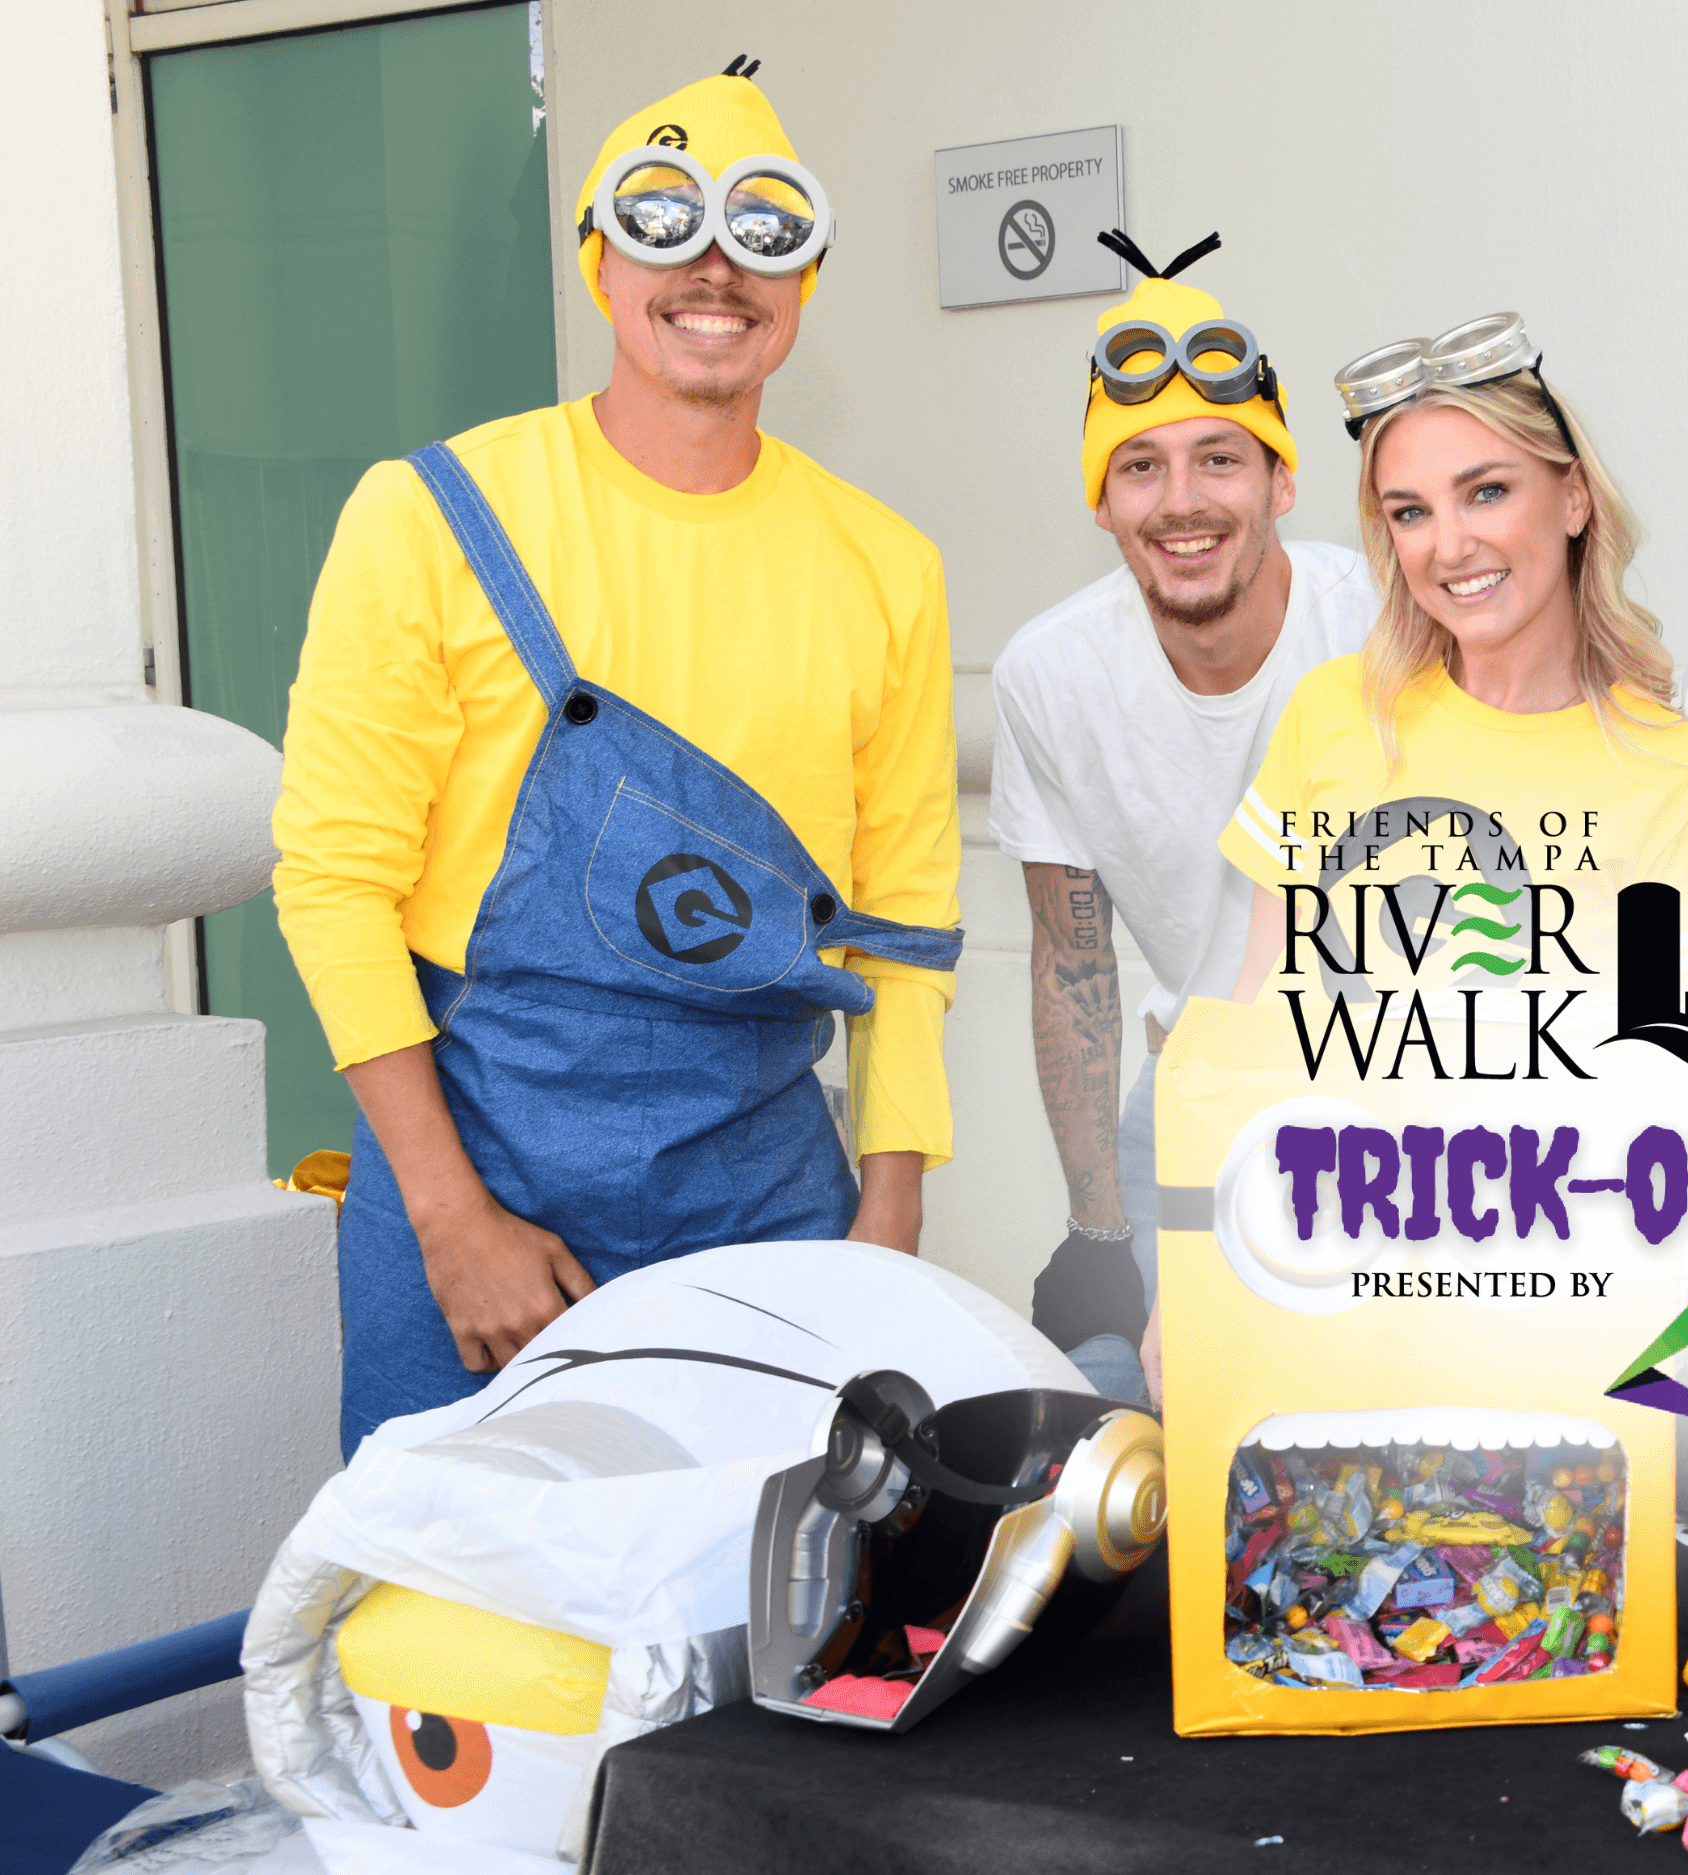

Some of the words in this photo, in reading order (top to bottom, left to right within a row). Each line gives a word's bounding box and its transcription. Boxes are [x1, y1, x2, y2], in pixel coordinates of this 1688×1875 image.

[948, 172, 995, 195] SMOKE
[998, 167, 1029, 188] FREE
[1031, 157, 1103, 183] PROPERTY
